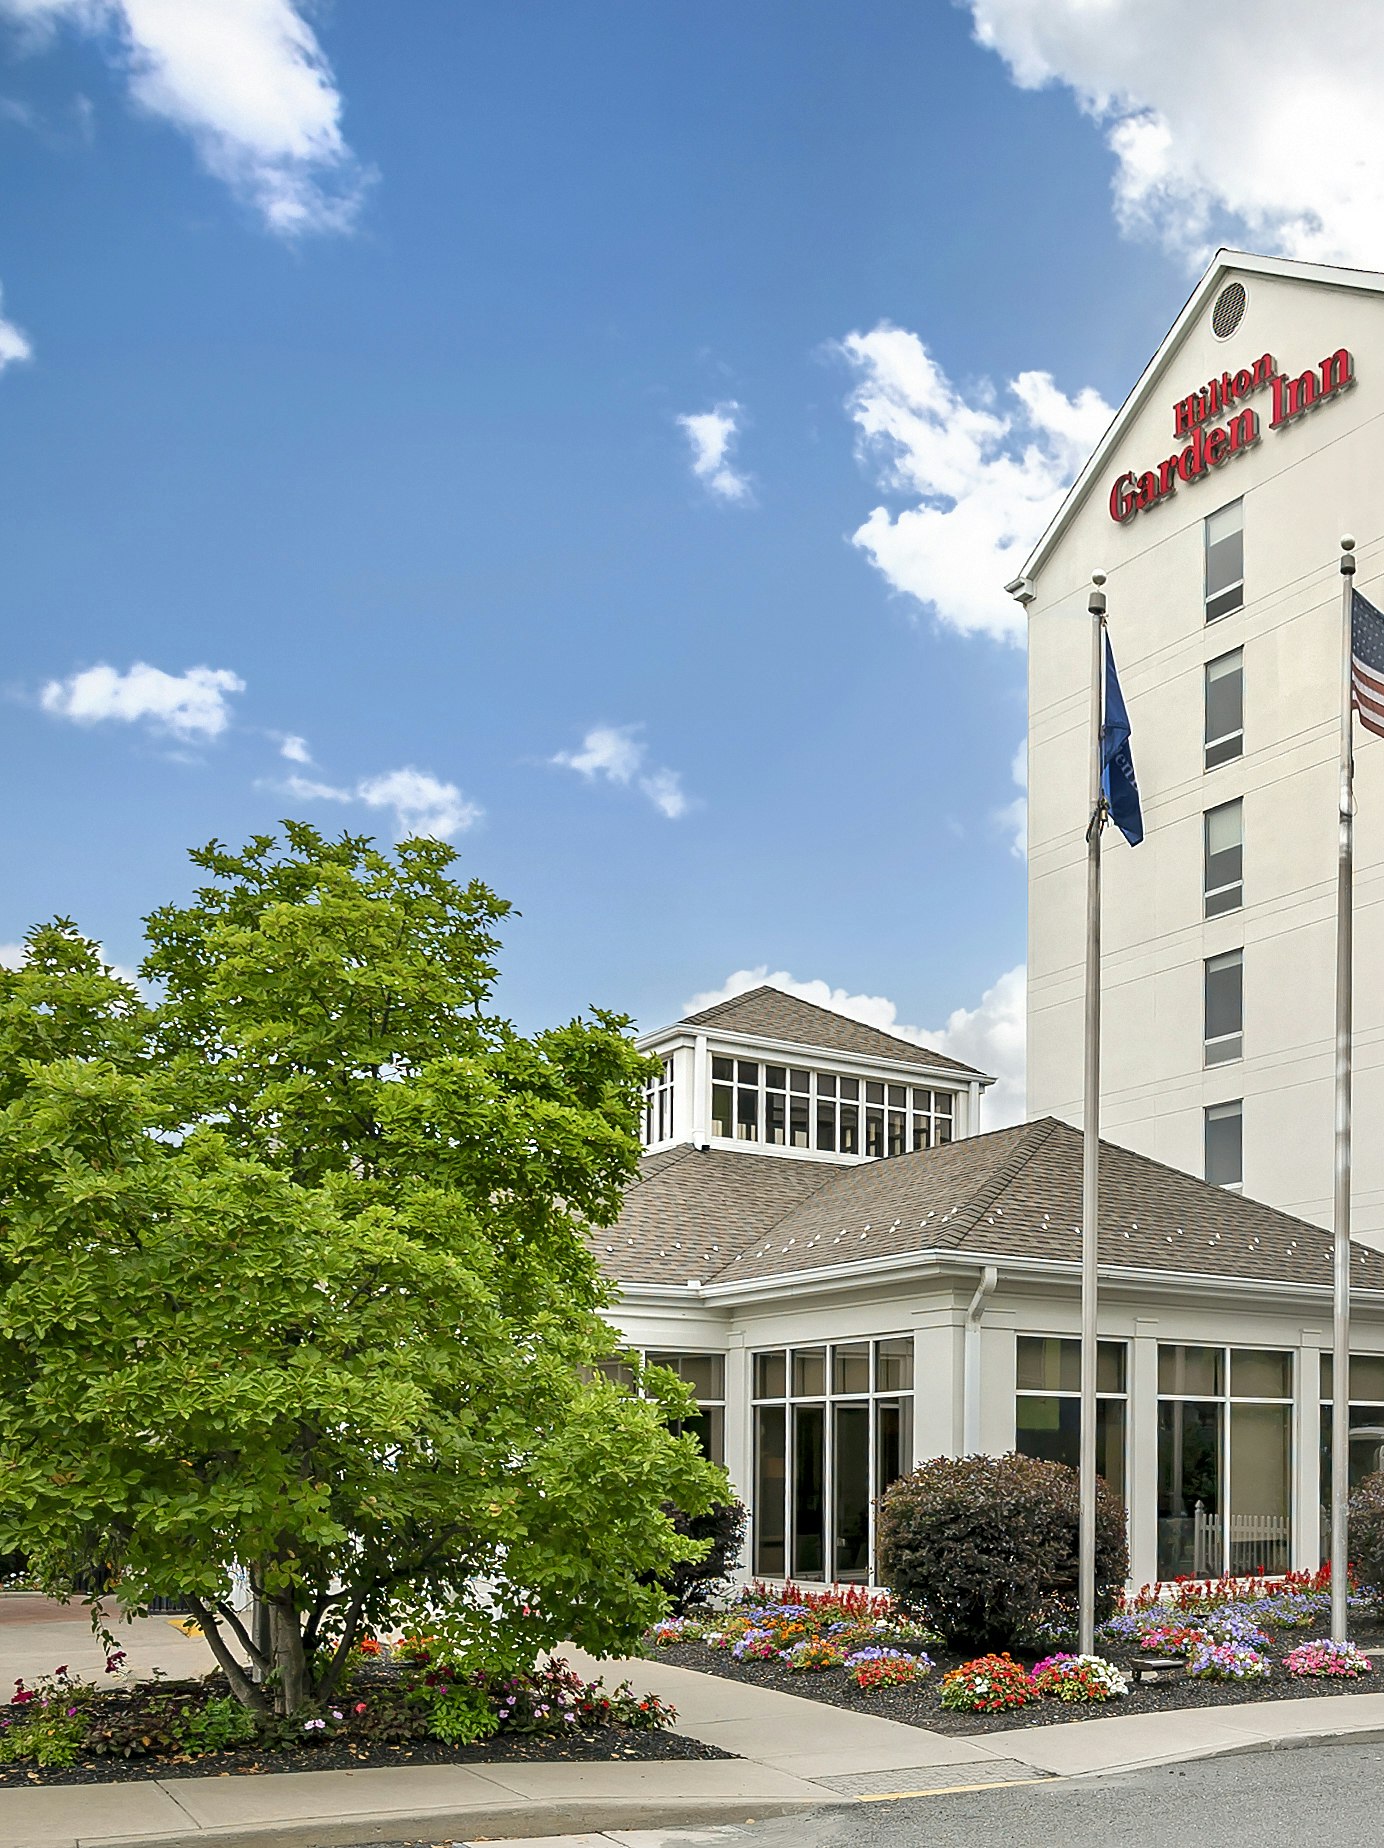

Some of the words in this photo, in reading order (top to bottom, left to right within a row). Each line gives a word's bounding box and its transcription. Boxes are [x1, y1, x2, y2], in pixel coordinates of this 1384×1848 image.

[1109, 407, 1260, 522] Garden
[1269, 347, 1355, 429] Inn
[1173, 353, 1276, 439] Hilton
